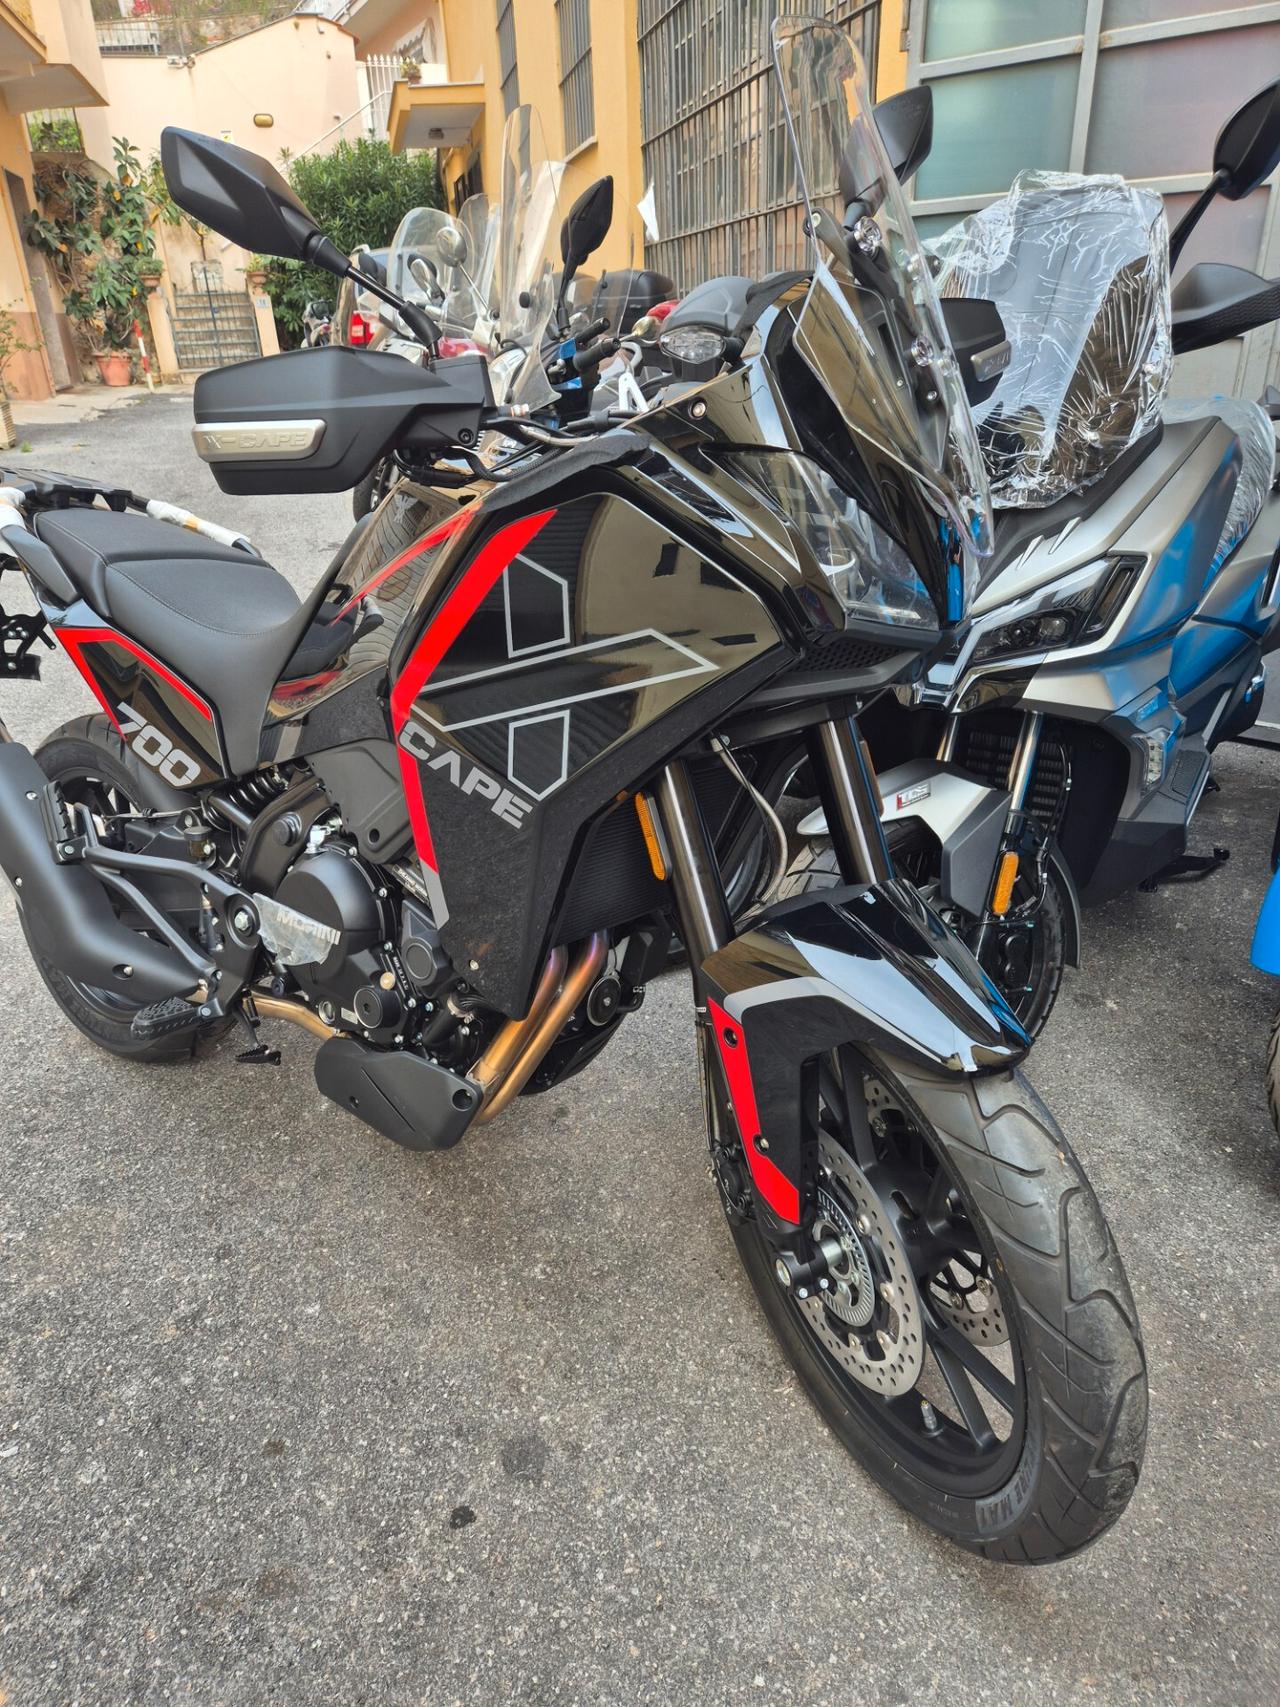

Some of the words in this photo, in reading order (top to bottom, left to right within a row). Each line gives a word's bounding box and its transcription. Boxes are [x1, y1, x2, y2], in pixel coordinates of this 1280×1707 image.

[203, 433, 306, 448] X-CAPE
[117, 702, 200, 786] 700
[399, 721, 533, 829] CAPE
